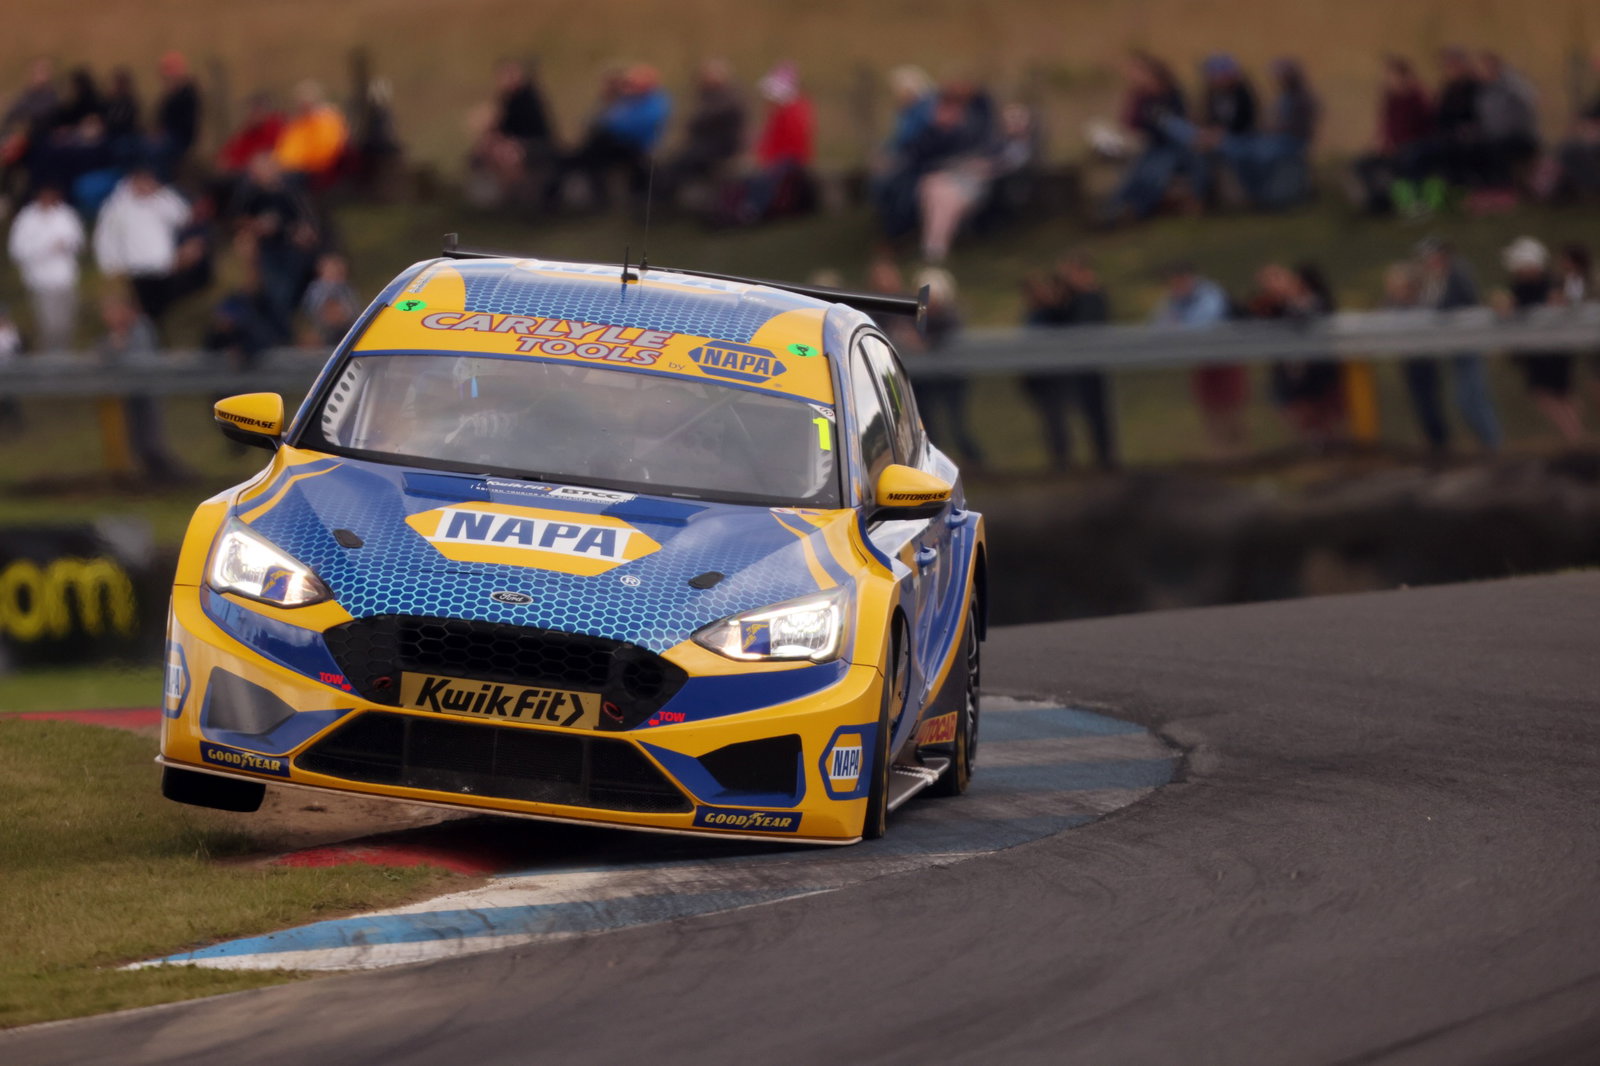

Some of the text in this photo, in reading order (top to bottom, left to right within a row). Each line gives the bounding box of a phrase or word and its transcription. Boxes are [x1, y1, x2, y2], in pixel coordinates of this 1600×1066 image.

[421, 312, 672, 349] CARLYLE
[515, 336, 663, 366] TOOLS
[668, 347, 771, 375] by NAPA
[217, 410, 276, 429] MOTORBASE
[812, 417, 832, 451] 1
[886, 490, 949, 501] MOTORBASE
[445, 511, 617, 557] NAPA
[319, 672, 345, 685] TOW
[658, 710, 686, 724] TOW
[832, 748, 859, 777] NAPA
